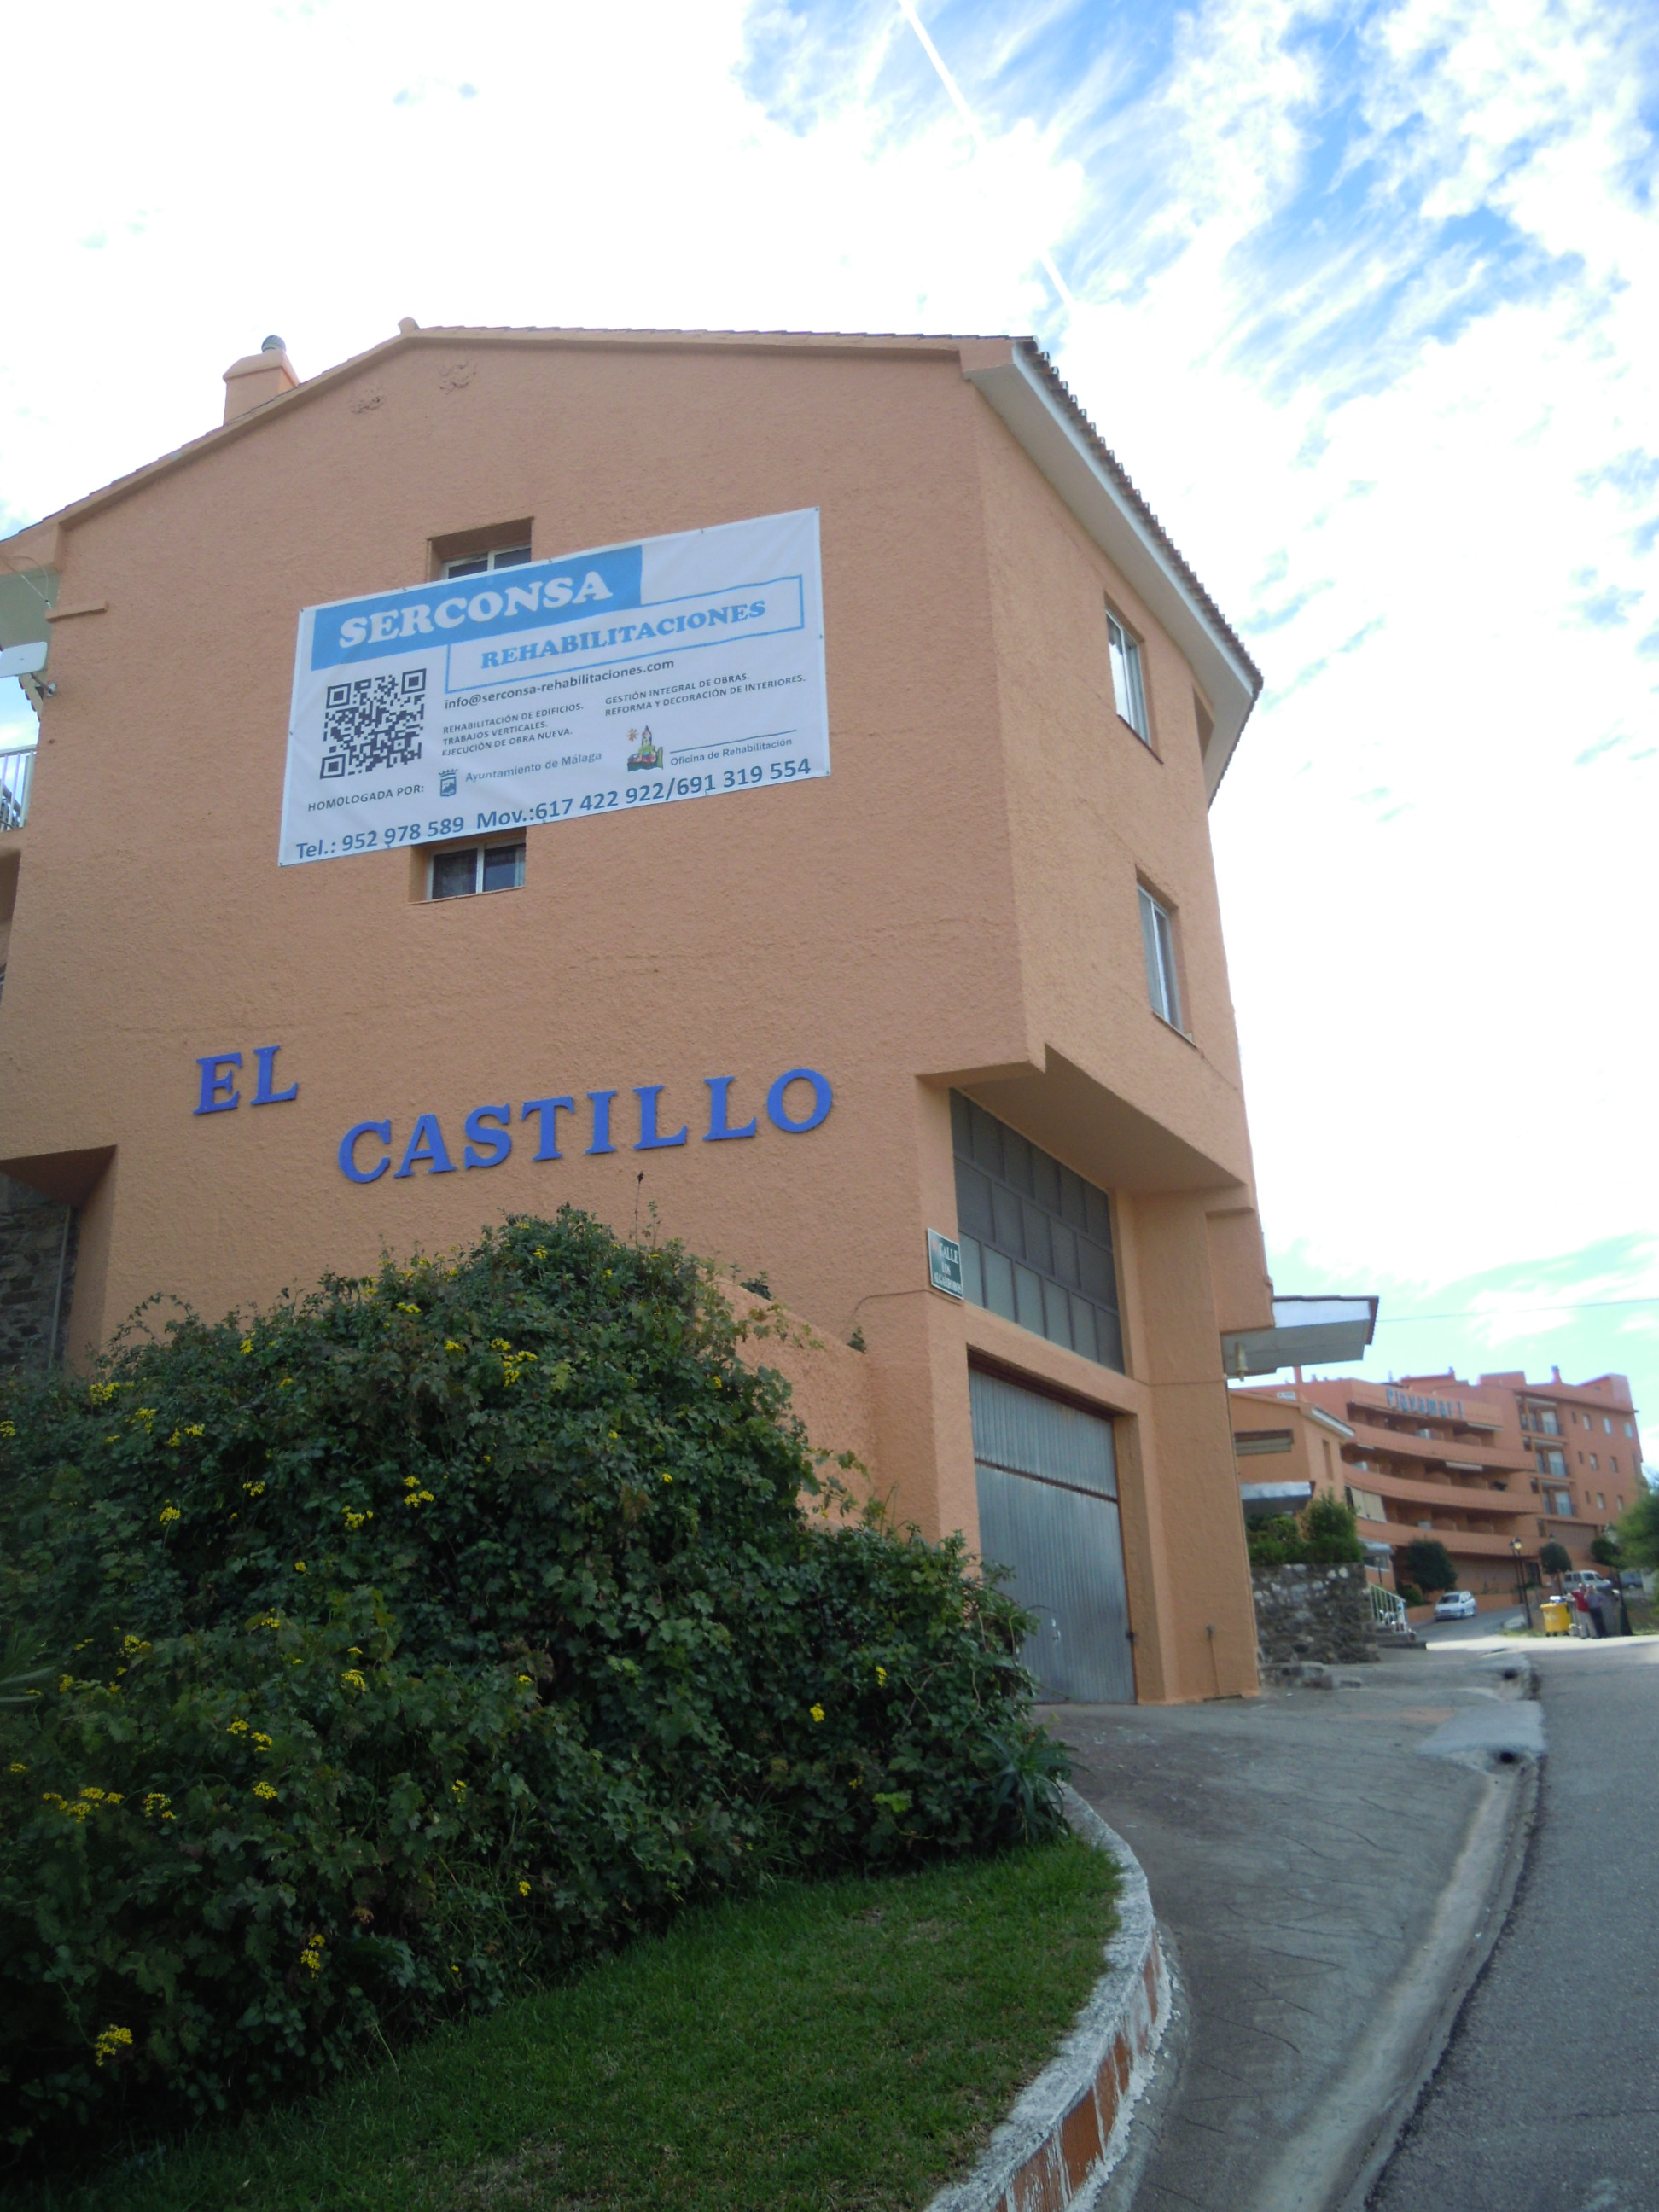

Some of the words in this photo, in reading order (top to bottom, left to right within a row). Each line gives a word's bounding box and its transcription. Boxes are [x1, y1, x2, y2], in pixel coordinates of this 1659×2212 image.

[339, 570, 614, 649] SERCONSA
[480, 600, 766, 669] REHABILITACIONES
[445, 660, 674, 709] info@serconsa-rehabilitaciones.com
[605, 690, 647, 705] GESTIÓN
[649, 683, 696, 697] INTEGRAL
[699, 679, 711, 688] DE
[713, 672, 750, 685] OBRAS.
[605, 701, 652, 717] REFORMA
[663, 688, 727, 706] DECORACIÓN
[730, 686, 742, 695] DE
[744, 674, 806, 692] INTERIORES.
[443, 713, 519, 734] REHABILITACIÓN
[521, 711, 533, 721] DE
[536, 702, 584, 719] EDIFICIOS.
[443, 731, 489, 745] TRABAJOS
[492, 721, 546, 736] VERTICALES.
[442, 740, 492, 756] EJECUCIÓN
[494, 739, 506, 748] DE
[509, 734, 535, 745] OBRA
[538, 728, 573, 740] NUEVA.
[671, 752, 705, 766] Oficina
[707, 750, 719, 760] de
[722, 738, 793, 757] Rehabilitación
[465, 763, 541, 783] Ayuntamiento
[545, 759, 558, 769] de
[562, 751, 602, 766] Málaga
[296, 839, 336, 859] Tel.:
[342, 830, 377, 852] 952
[384, 824, 421, 844] 978
[427, 816, 464, 837] 589
[579, 790, 619, 812] 422
[626, 774, 716, 804] 922/691
[723, 765, 762, 789] 319
[770, 757, 811, 780] 554
[308, 790, 393, 812] HOMOLOGADA
[396, 784, 424, 796] POR:
[193, 1045, 299, 1115] EL
[339, 1068, 833, 1183] CASTILLO
[939, 1243, 958, 1264] CALLE
